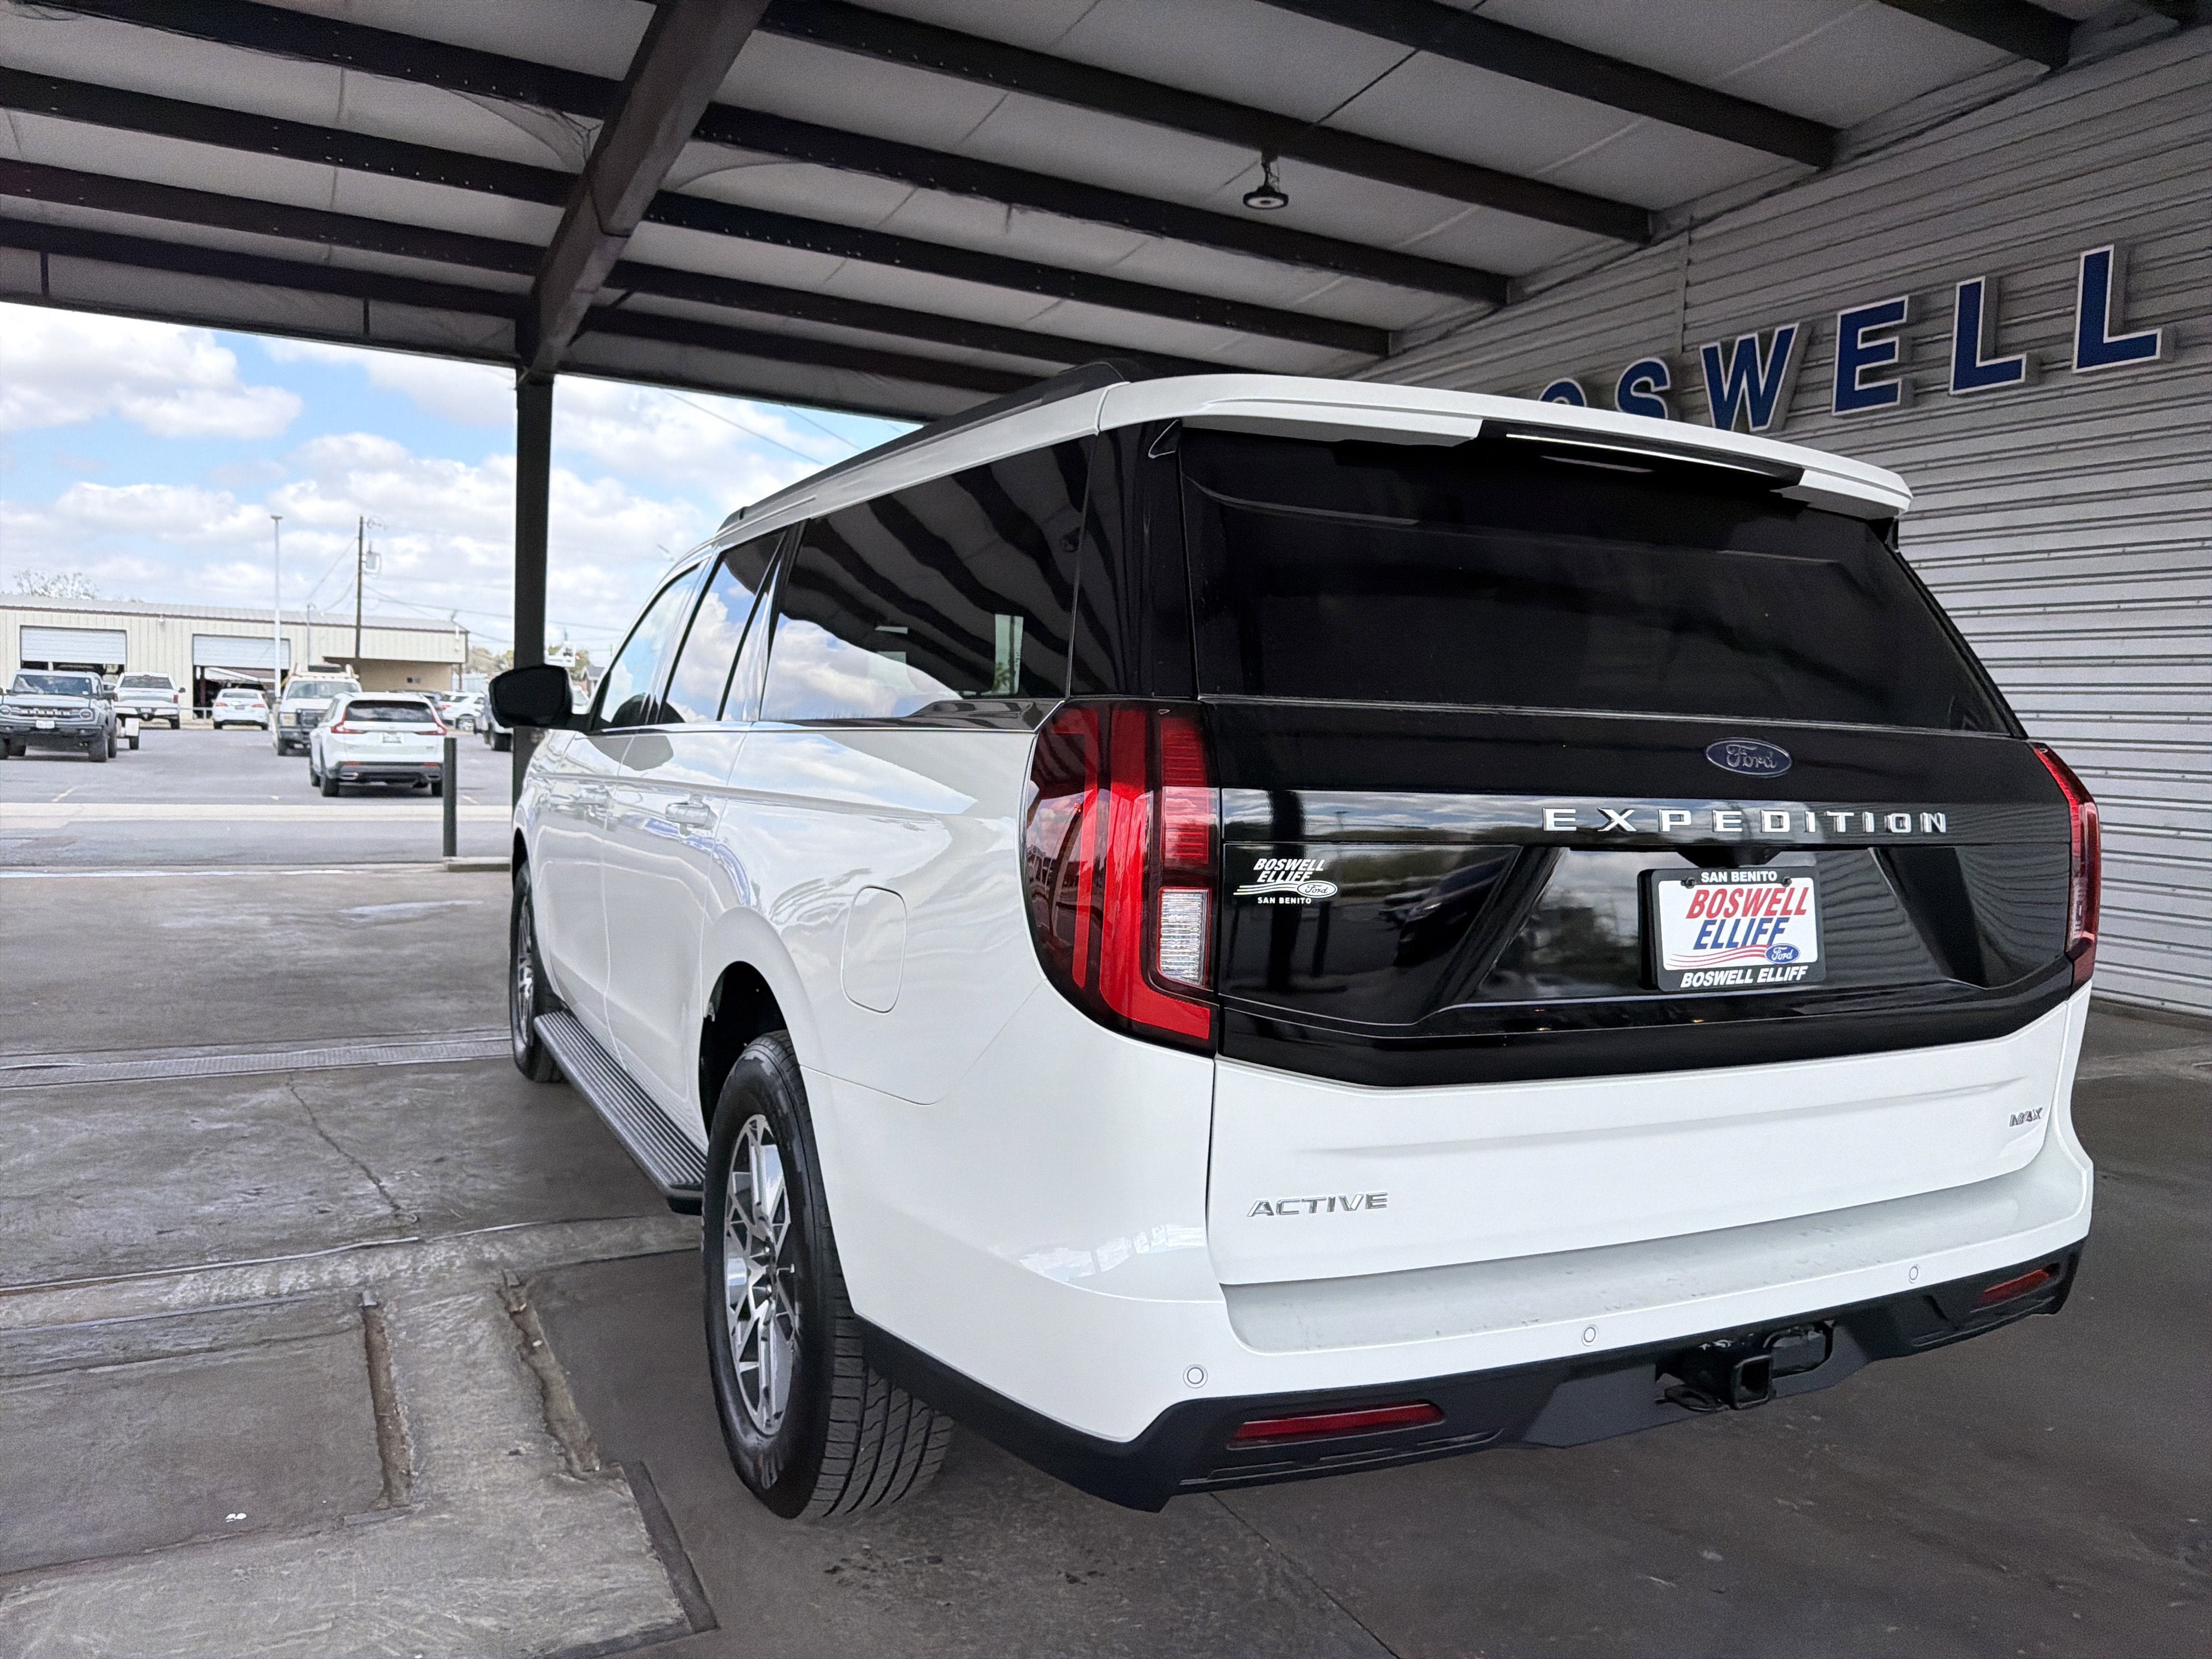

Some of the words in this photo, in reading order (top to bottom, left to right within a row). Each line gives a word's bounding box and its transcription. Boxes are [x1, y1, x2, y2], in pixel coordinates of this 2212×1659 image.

[1726, 744, 1777, 769] Ford
[1542, 807, 1946, 833] EXPEDITION
[1253, 859, 1325, 871] BOSWELL
[1701, 871, 1727, 883] SAN
[1731, 871, 1777, 882] BENITO
[1305, 884, 1328, 894] Ford
[1686, 887, 1809, 919] BOSWELL
[1693, 917, 1790, 950] ELLIFF
[1771, 947, 1793, 961] Ford
[1680, 968, 1754, 988] BOSWELL
[1757, 966, 1808, 983] ELLIFF
[2009, 1107, 2043, 1126] MAX
[1246, 1191, 1388, 1217] ACTIVE
